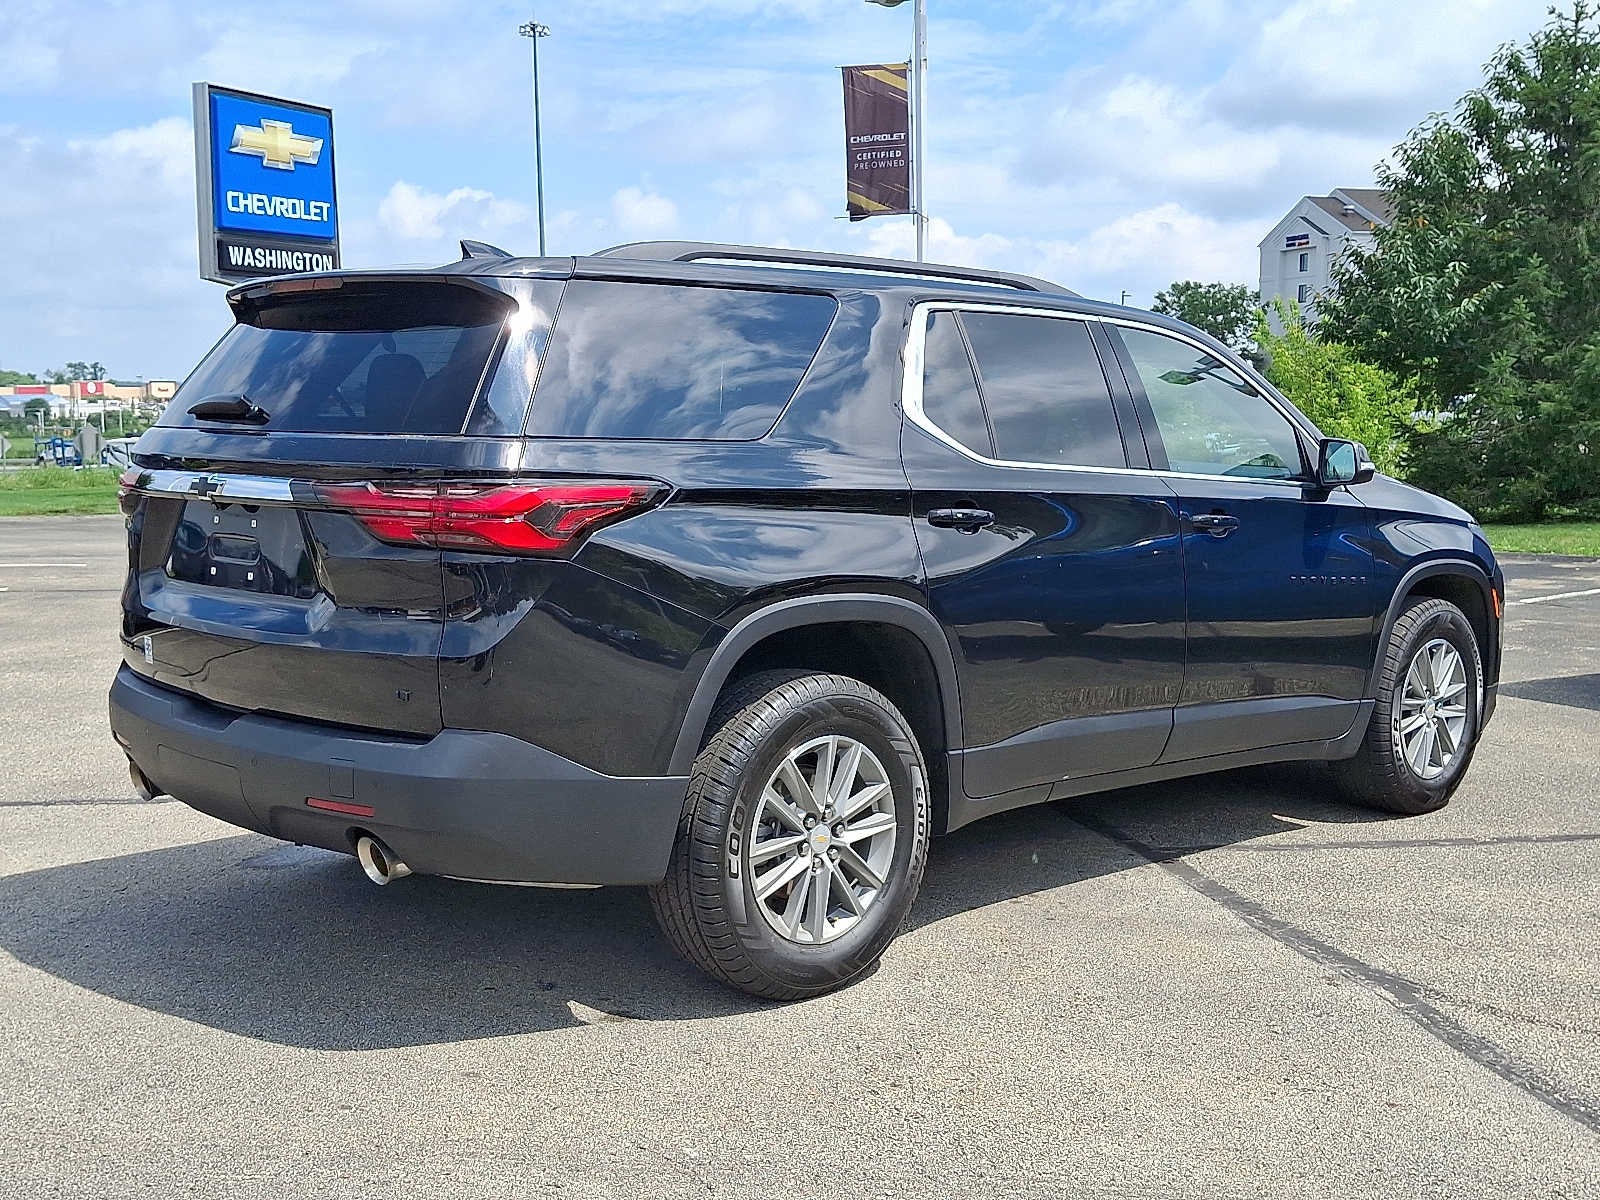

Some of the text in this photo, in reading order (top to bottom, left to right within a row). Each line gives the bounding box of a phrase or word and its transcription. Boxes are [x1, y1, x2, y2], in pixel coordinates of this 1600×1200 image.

[850, 132, 906, 144] CHEVROLET
[854, 159, 905, 170] PRE-OWNED
[226, 190, 331, 222] CHEVROLET
[228, 245, 333, 271] WASHINGTON
